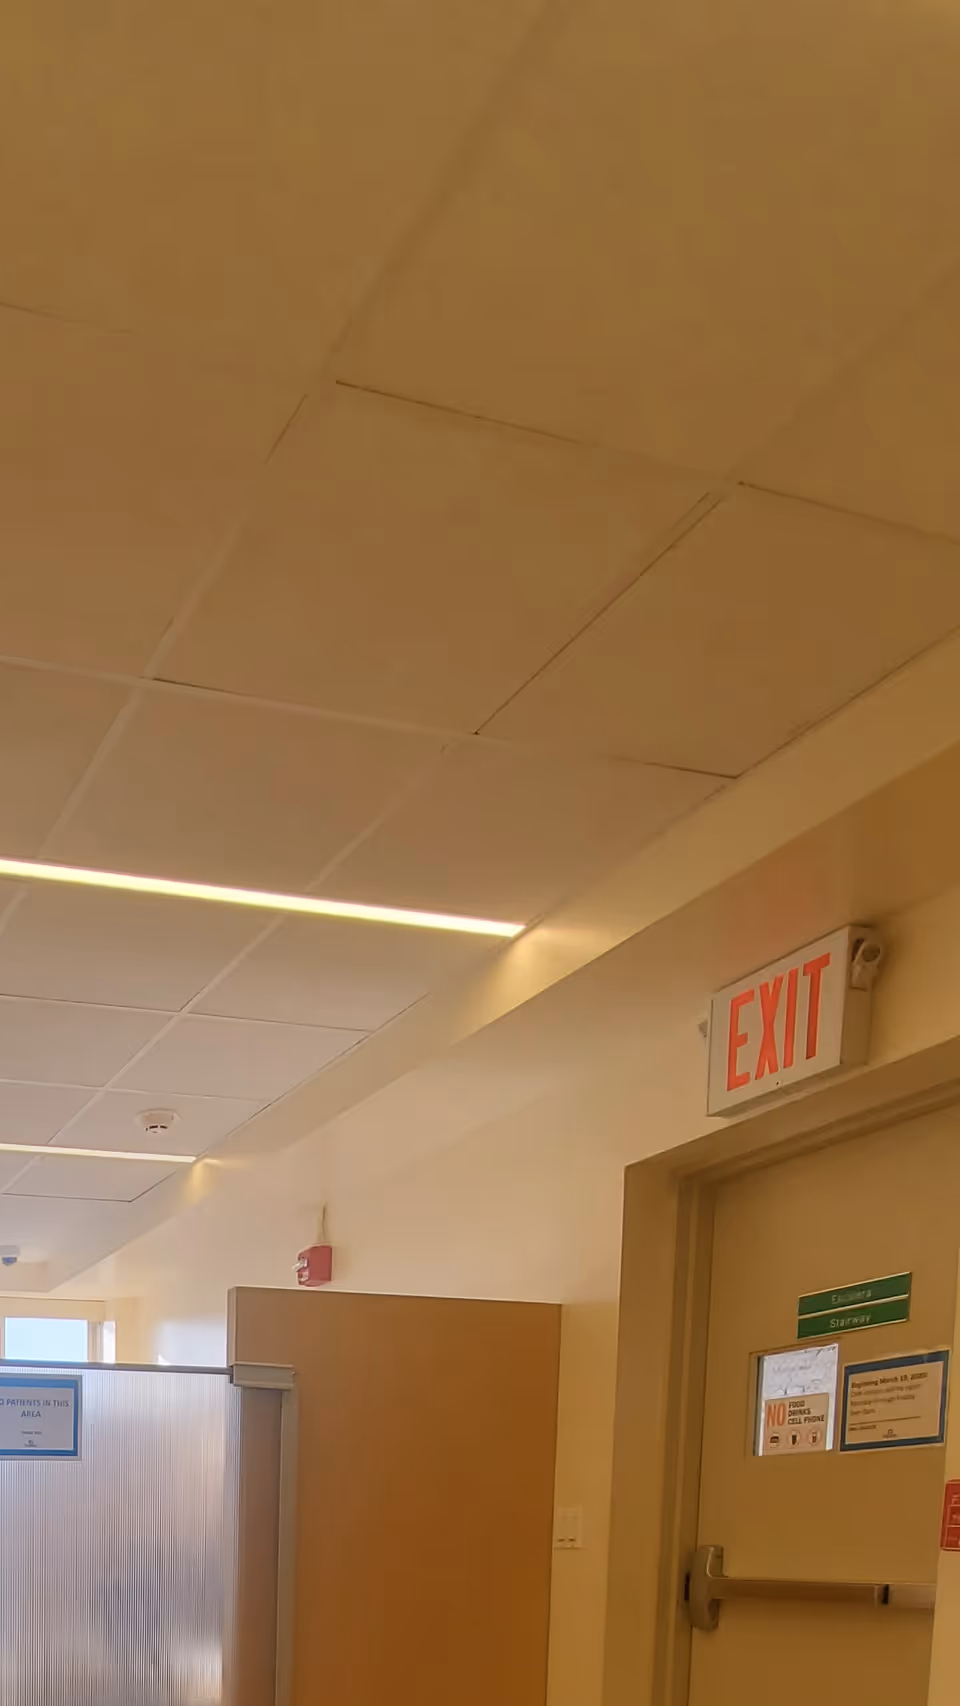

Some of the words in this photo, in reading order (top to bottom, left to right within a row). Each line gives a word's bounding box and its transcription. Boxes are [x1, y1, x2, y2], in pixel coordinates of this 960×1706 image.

[727, 952, 831, 1092] EXIT
[829, 1313, 872, 1328] Stairway
[6, 1398, 41, 1407] PATIENTS
[52, 1399, 69, 1407] THIS
[788, 1400, 806, 1409] FOOD
[20, 1410, 41, 1418] AREA
[767, 1402, 787, 1428] NO
[788, 1408, 811, 1418] DRINKS
[787, 1416, 803, 1425] CELL
[803, 1414, 825, 1425] PHONE
